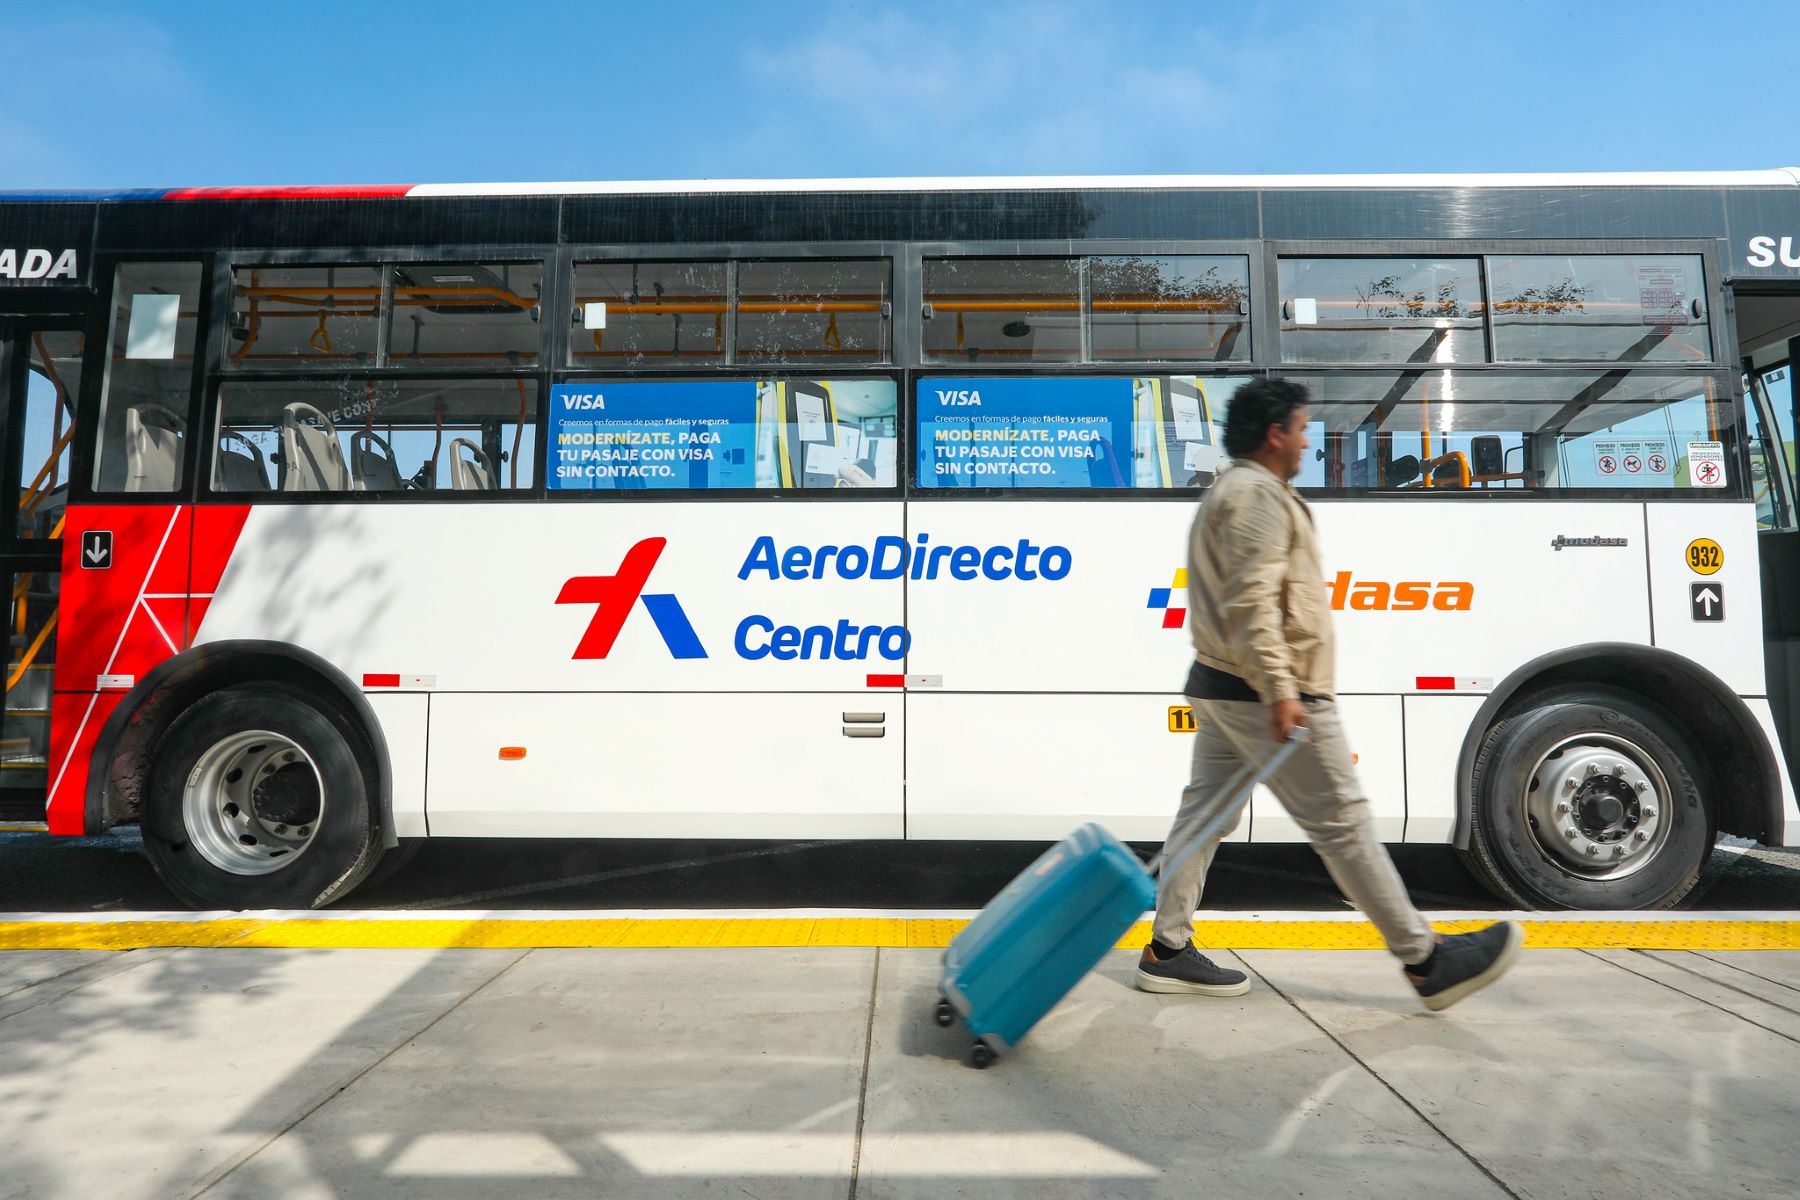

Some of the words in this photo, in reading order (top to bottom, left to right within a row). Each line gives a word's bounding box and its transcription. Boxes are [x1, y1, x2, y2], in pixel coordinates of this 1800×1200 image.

[560, 394, 605, 410] VISA
[935, 390, 982, 406] VISA
[558, 419, 593, 427] Creemos
[605, 418, 633, 427] formas
[633, 418, 643, 427] de
[644, 419, 664, 429] pago
[665, 418, 691, 426] fáciles
[692, 419, 697, 427] y
[698, 419, 729, 427] seguras
[934, 415, 970, 423] Creemos
[982, 414, 1010, 423] formas
[1010, 415, 1021, 423] de
[1022, 416, 1042, 424] pago
[1043, 415, 1069, 423] fáciles
[1070, 416, 1076, 424] y
[1077, 416, 1108, 424] seguras
[557, 430, 676, 446] MODERNÍZATE,
[678, 432, 722, 445] PAGA
[935, 427, 1055, 443] MODERNÍZATE,
[1057, 429, 1101, 441] PAGA
[557, 449, 578, 461] TU
[581, 449, 639, 461] PASAJE
[641, 448, 676, 461] CON
[678, 448, 714, 460] VISA
[934, 445, 957, 458] TU
[960, 445, 1018, 458] PASAJE
[1020, 445, 1055, 458] CON
[1058, 445, 1094, 458] VISA
[556, 465, 583, 478] SIN
[584, 465, 676, 477] CONTACTO.
[935, 462, 961, 475] SIN
[964, 462, 1057, 475] CONTACTO.
[737, 532, 1073, 581] AeroDirecto
[1690, 546, 1720, 567] 932
[734, 614, 912, 661] Centro
